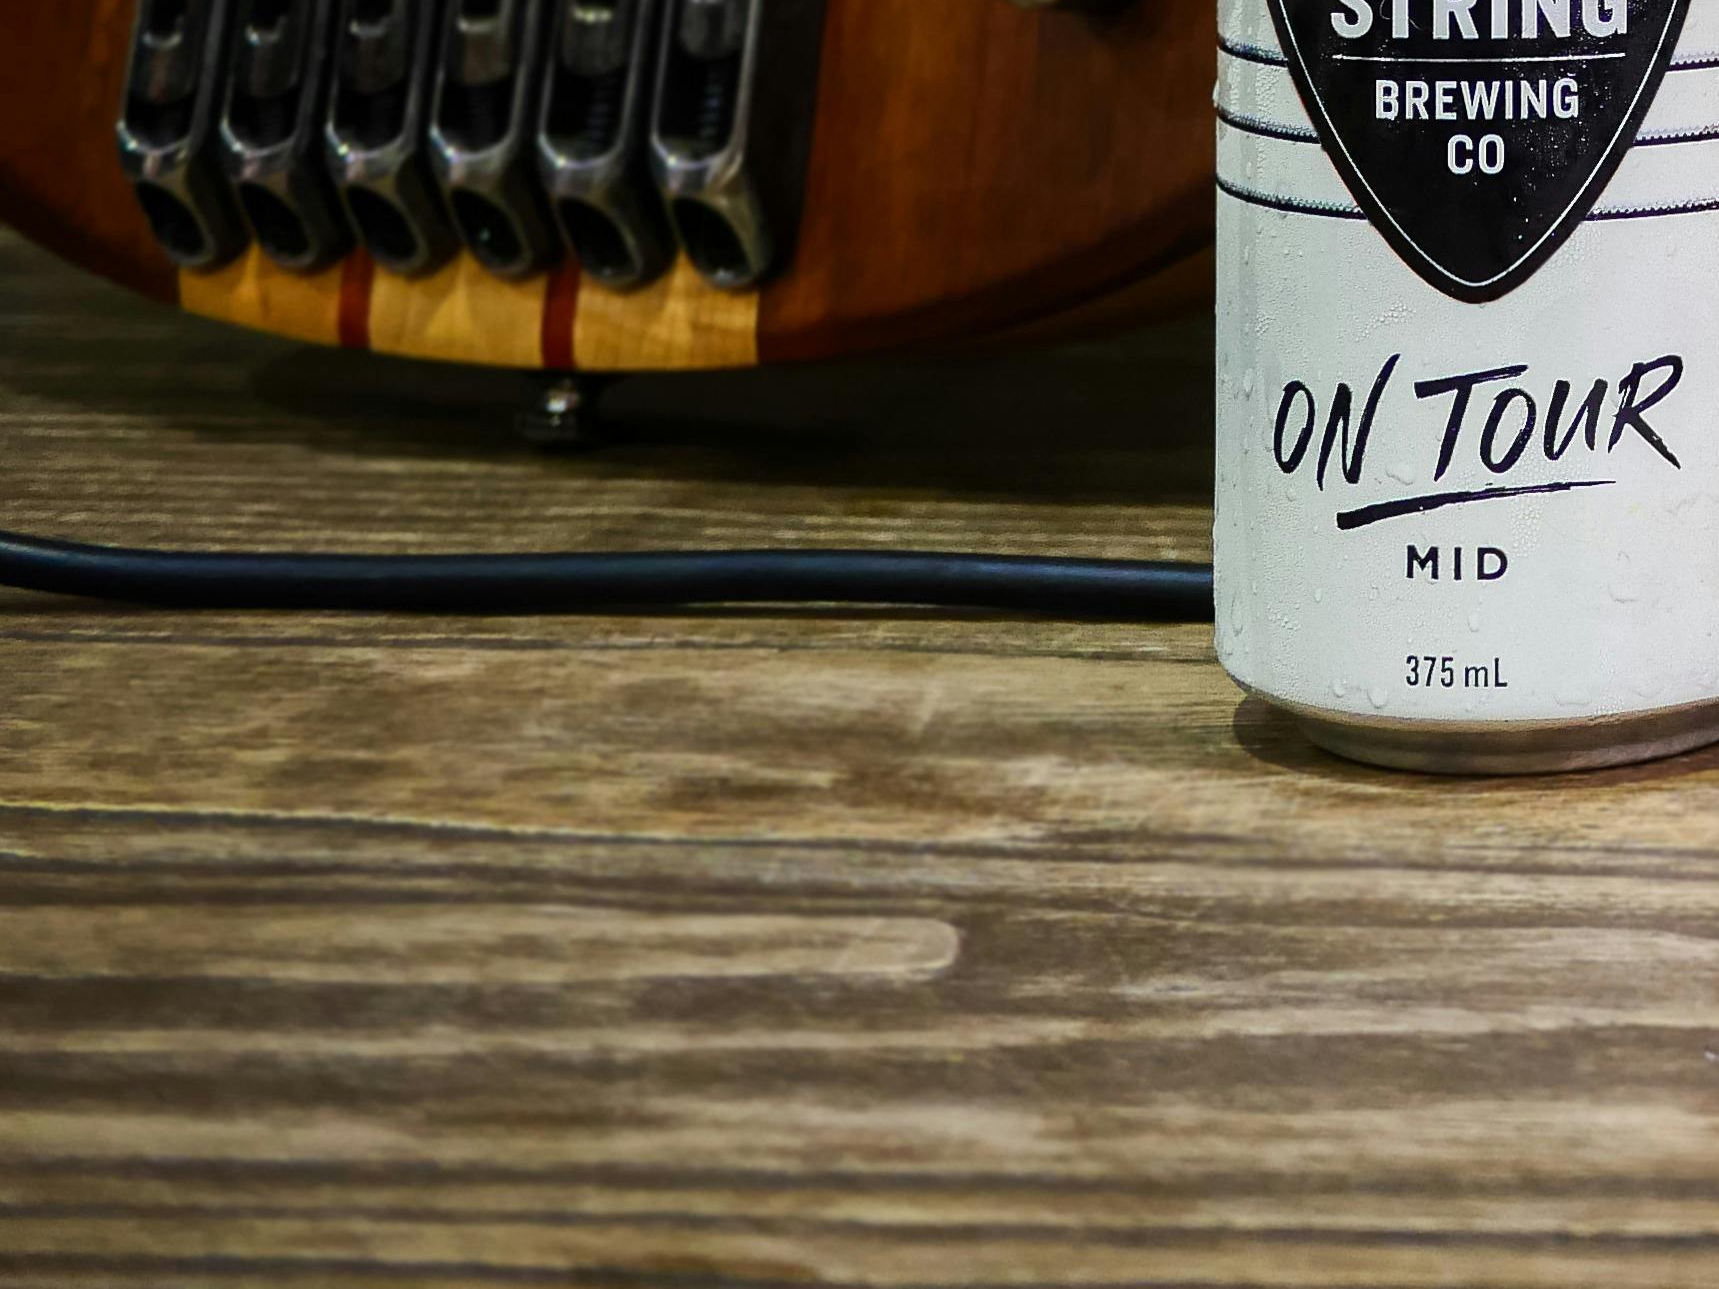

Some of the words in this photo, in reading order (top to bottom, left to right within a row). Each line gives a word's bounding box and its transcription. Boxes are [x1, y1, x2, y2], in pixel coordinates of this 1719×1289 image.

[1375, 77, 1579, 120] BREWING
[1447, 135, 1505, 174] CO
[1273, 353, 1401, 492] ON
[1414, 354, 1683, 481] TOUR
[1406, 544, 1510, 581] MID
